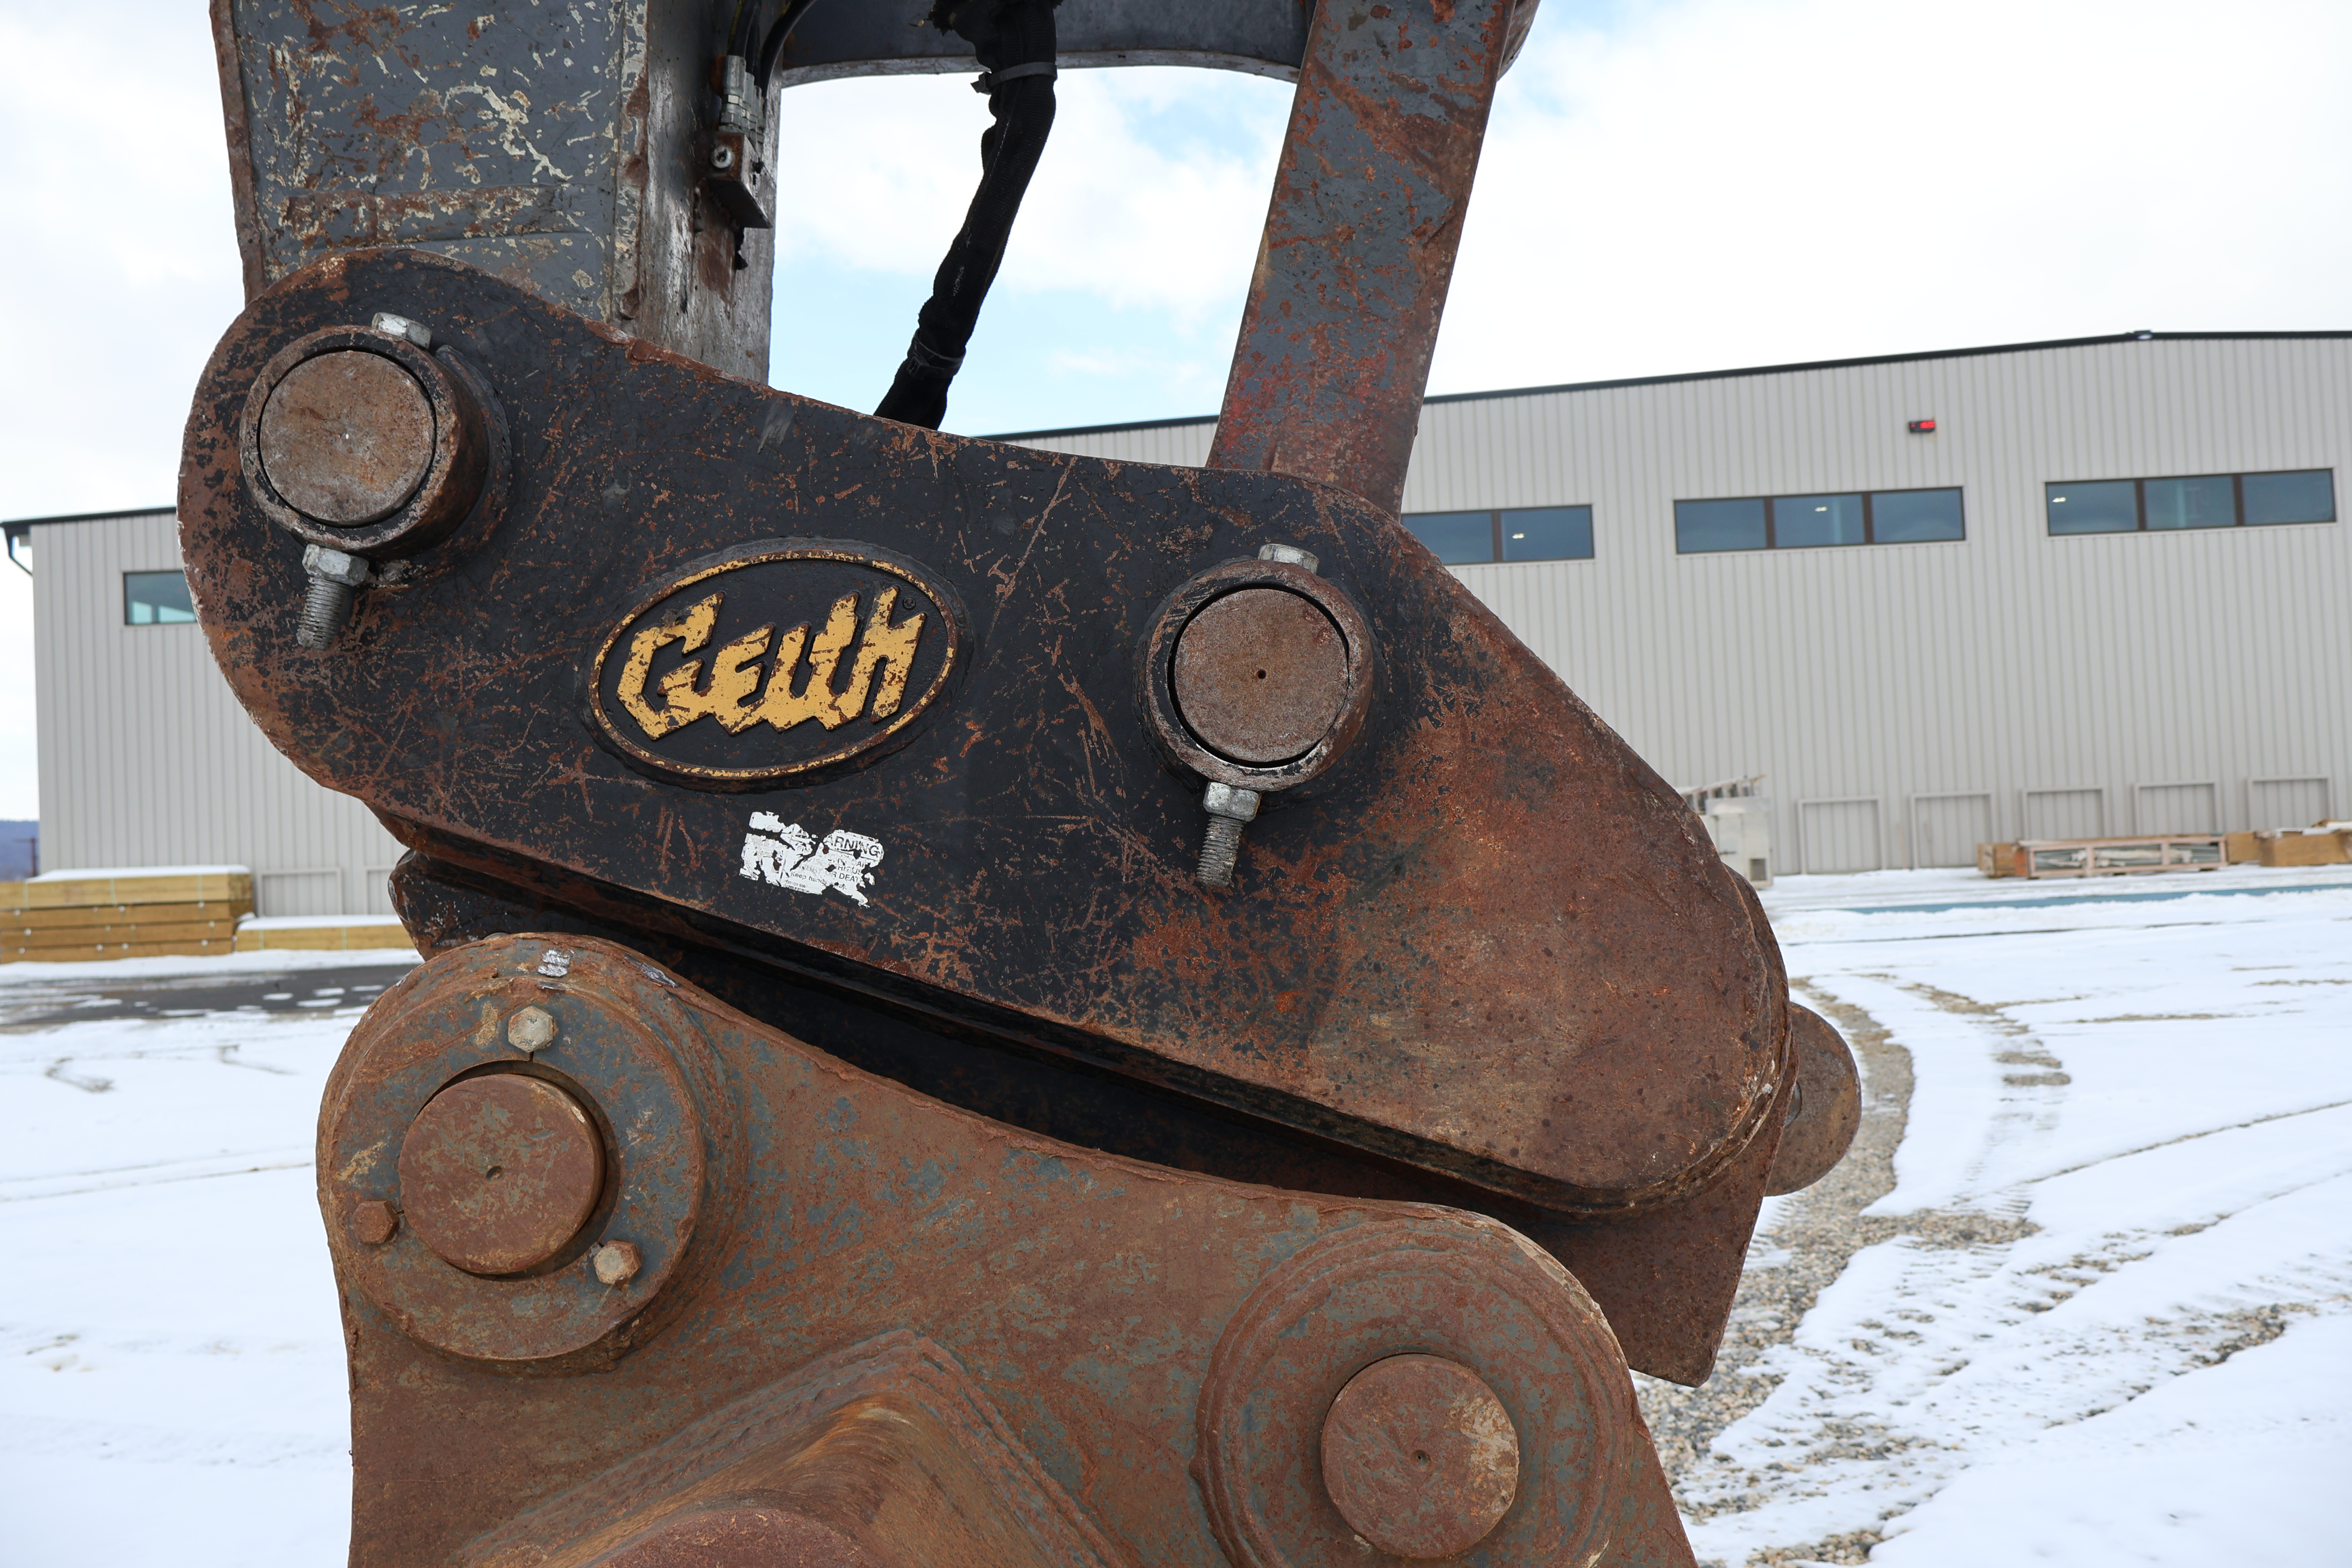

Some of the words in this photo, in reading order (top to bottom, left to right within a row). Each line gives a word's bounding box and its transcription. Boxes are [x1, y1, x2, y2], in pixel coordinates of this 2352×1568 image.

[824, 835, 880, 856] ARNING
[791, 871, 806, 880] Keep
[839, 872, 860, 883] DEAT
